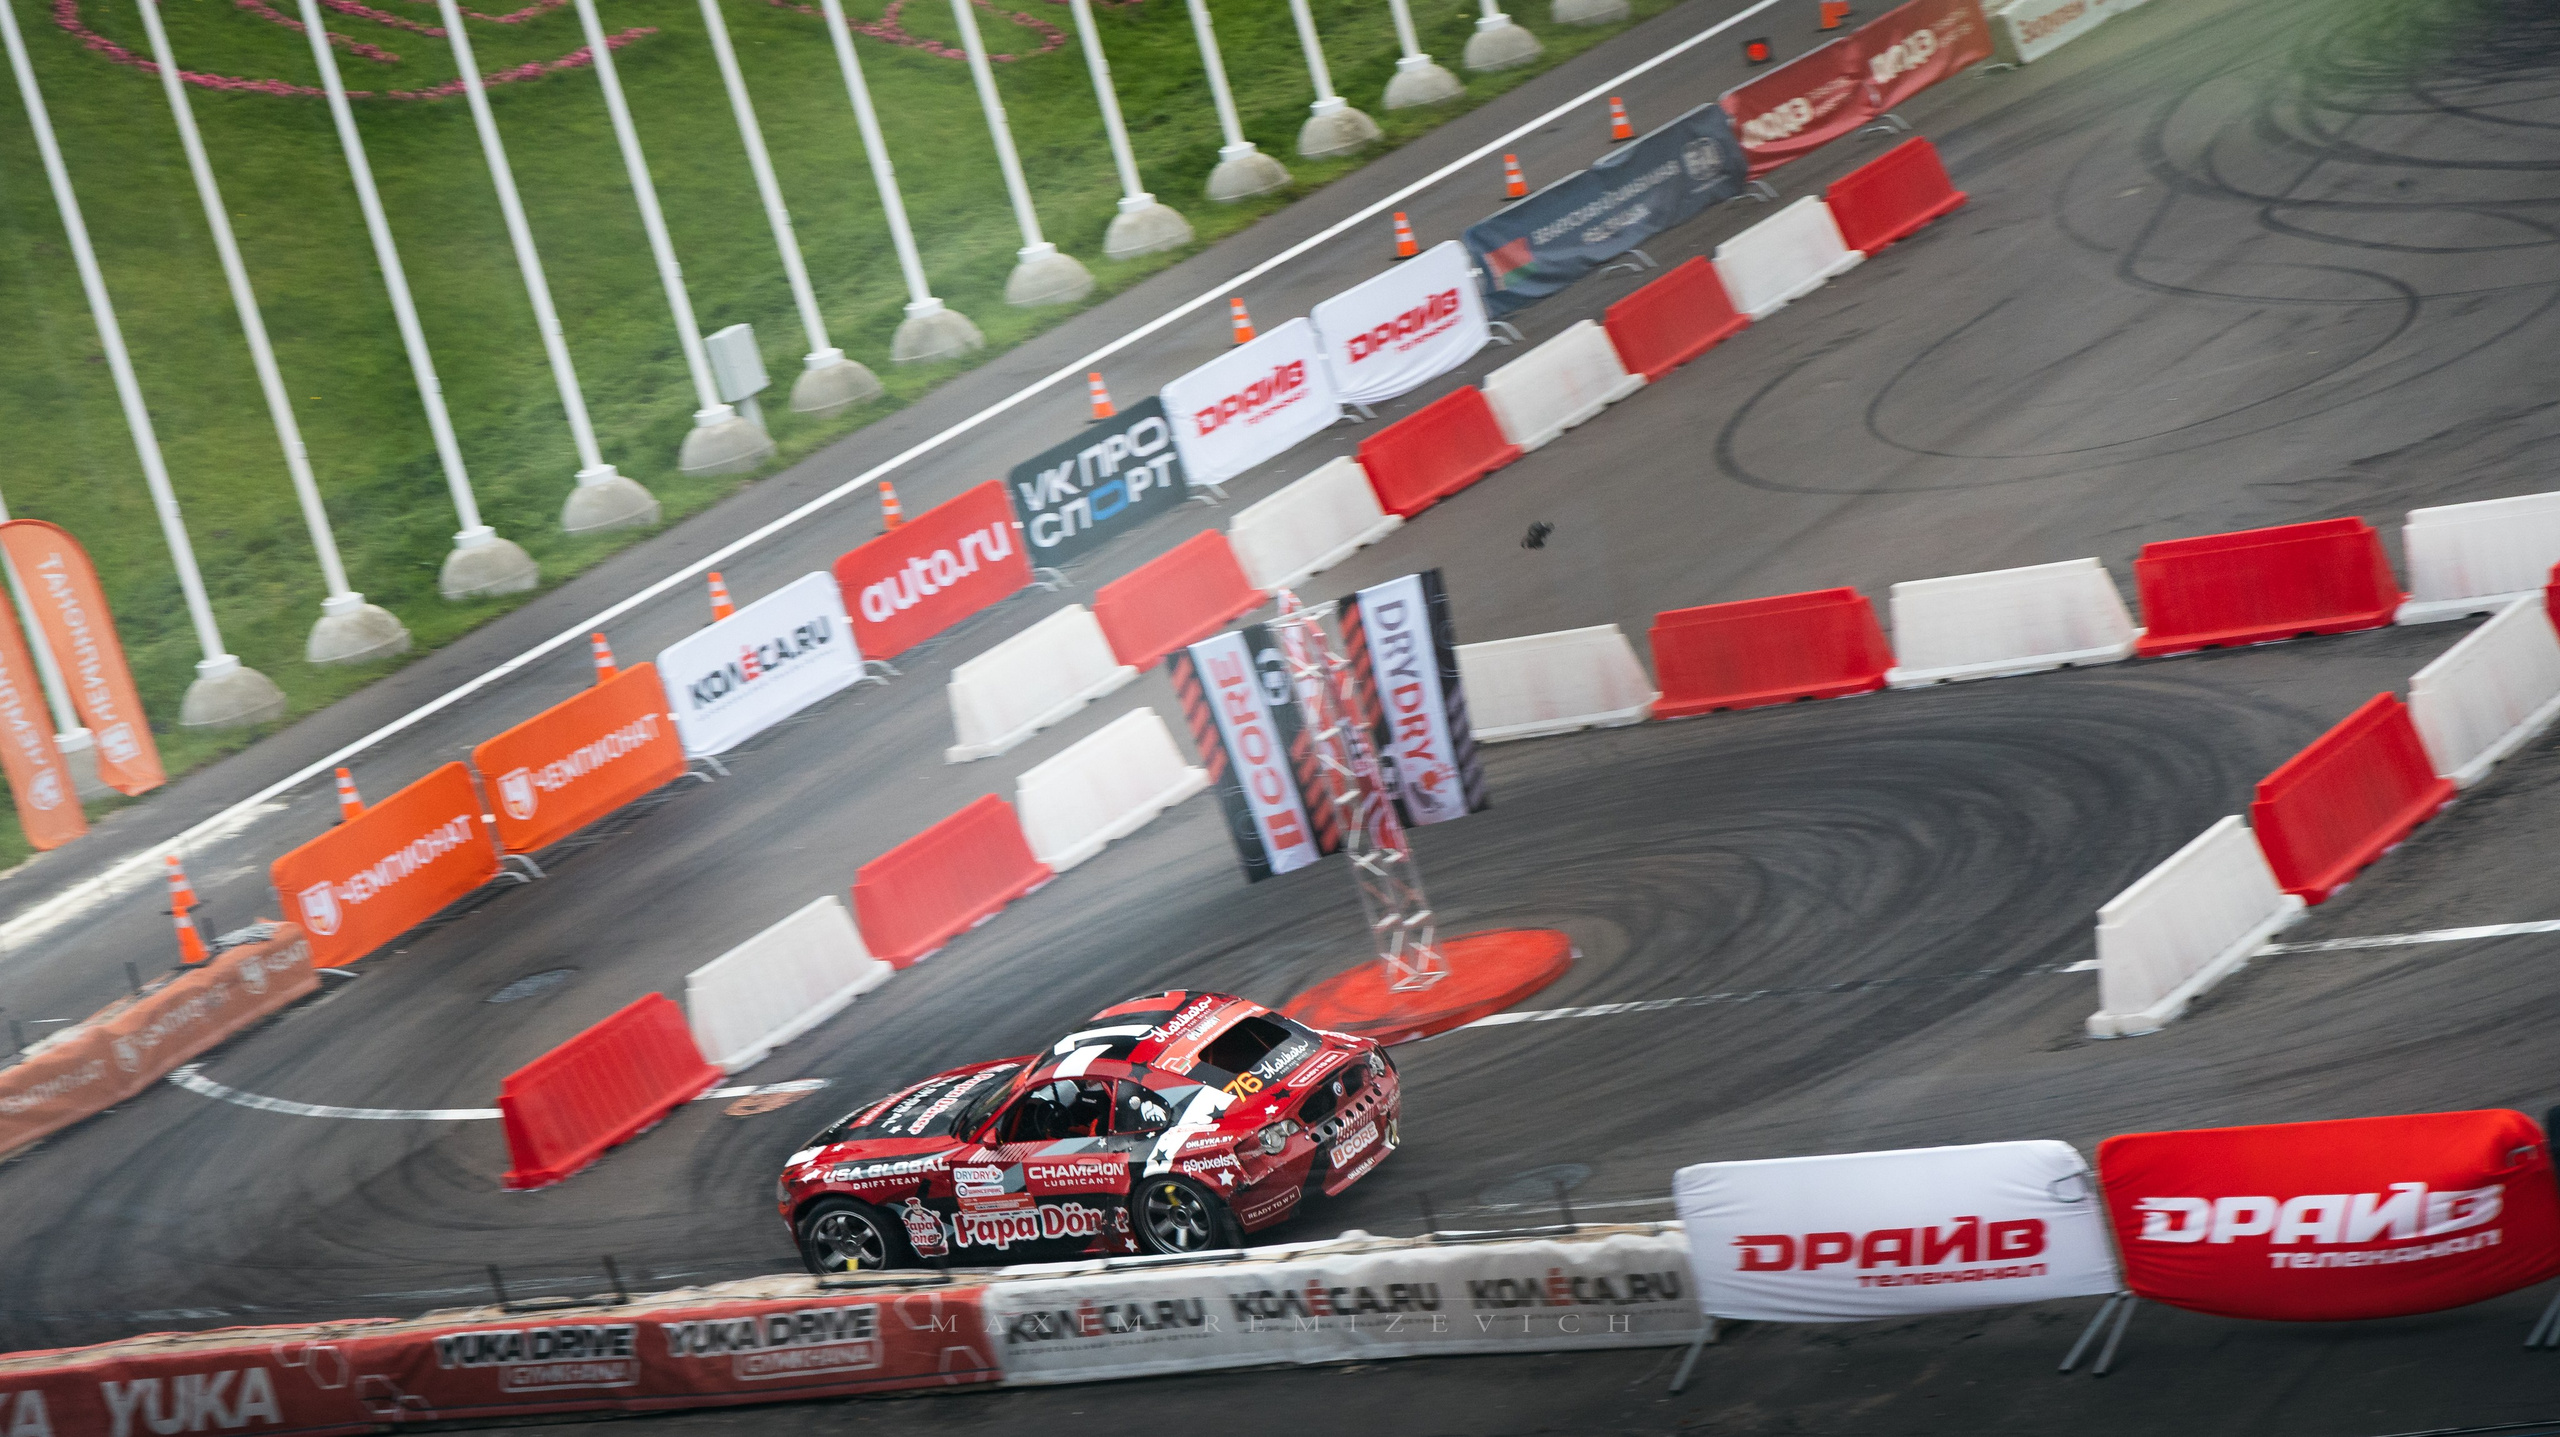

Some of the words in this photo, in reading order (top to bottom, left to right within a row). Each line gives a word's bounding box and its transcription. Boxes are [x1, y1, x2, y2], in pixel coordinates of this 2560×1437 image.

[1018, 460, 1081, 512] VK
[1077, 416, 1170, 487] ПРО
[1029, 452, 1178, 547] СПОРТ
[860, 521, 1012, 622] auto.ru
[1374, 600, 1438, 761] DRYDRY
[1222, 1072, 1264, 1103] 76
[1185, 1135, 1233, 1149] OKLEYKA.BY
[823, 1168, 862, 1184] USA
[867, 1157, 950, 1178] GLOBAL
[956, 1171, 991, 1180] DRYDRY
[1028, 1162, 1125, 1180] CHAMPION
[1183, 1155, 1240, 1174] 69pixels.
[853, 1179, 887, 1190] DRIFT
[890, 1176, 920, 1187] TEAM
[955, 1214, 1035, 1247] Papa
[1042, 1206, 1129, 1234] Dönr
[1247, 1206, 1272, 1219] READY
[911, 1232, 940, 1244] öner
[434, 1331, 525, 1369] YUKA
[530, 1324, 635, 1360] DRIVE
[660, 1317, 758, 1358] YUKA
[765, 1304, 878, 1347] DRIVE
[100, 1367, 285, 1437] YUKA
